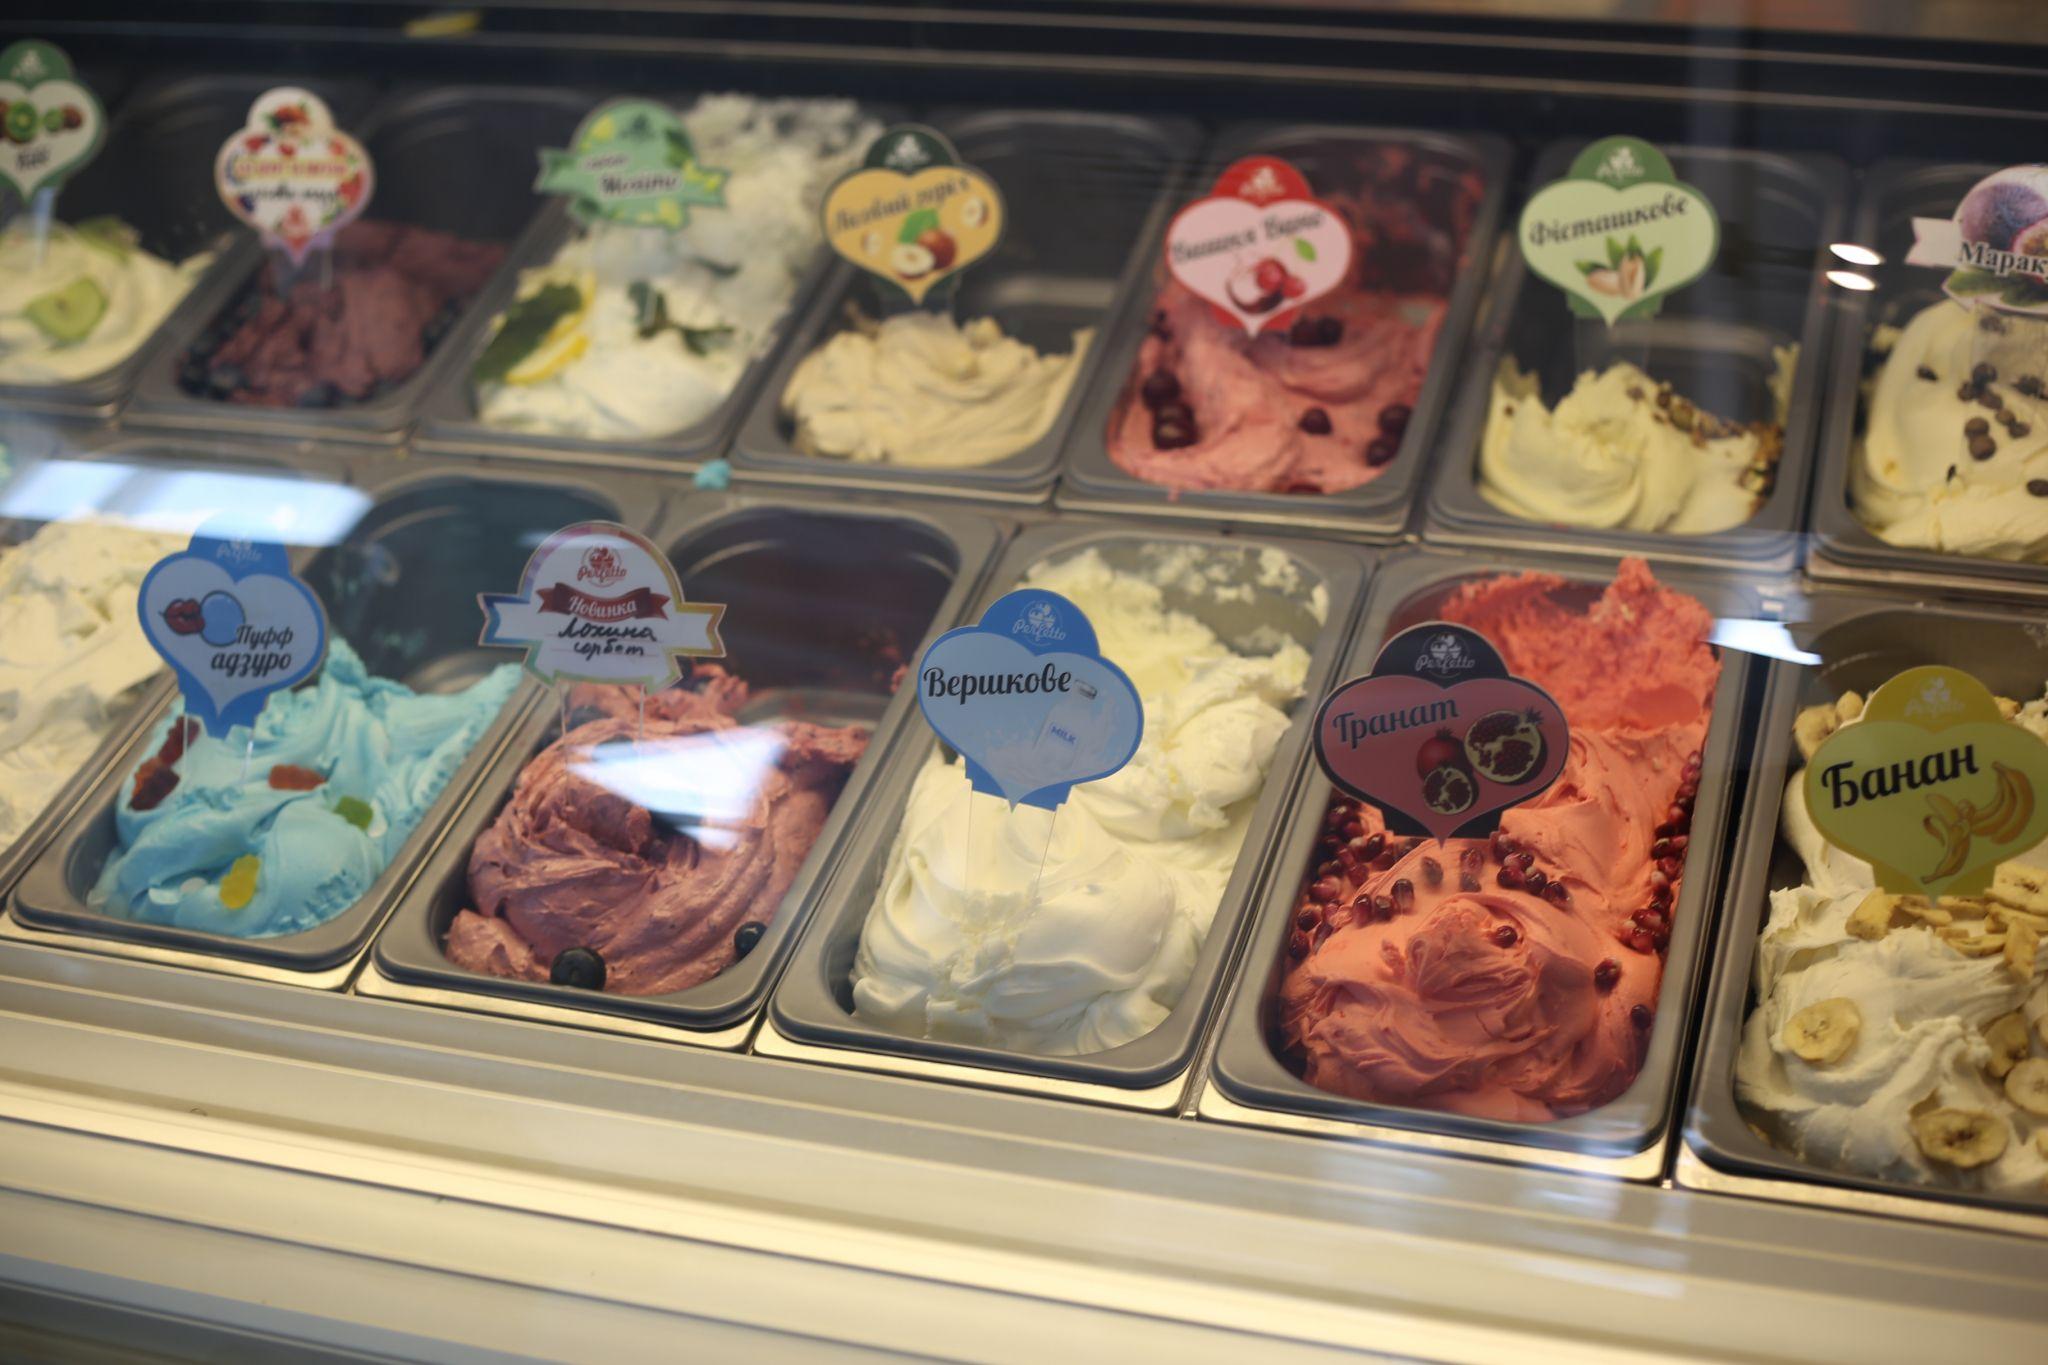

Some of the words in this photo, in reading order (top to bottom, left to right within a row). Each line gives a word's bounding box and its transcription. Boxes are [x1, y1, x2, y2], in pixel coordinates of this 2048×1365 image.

[1528, 191, 1689, 247] Фісташкове
[1958, 242, 2048, 282] Марак
[567, 595, 638, 619] Новинка
[236, 624, 294, 650] Пуфф
[1012, 618, 1068, 643] Perfetto
[211, 651, 292, 678] адзуро
[1415, 652, 1477, 676] Perfetto
[923, 661, 1072, 706] Вершкове
[1051, 724, 1077, 745] MILK
[1332, 698, 1459, 750] Гранат
[1821, 743, 1980, 810] Банан
